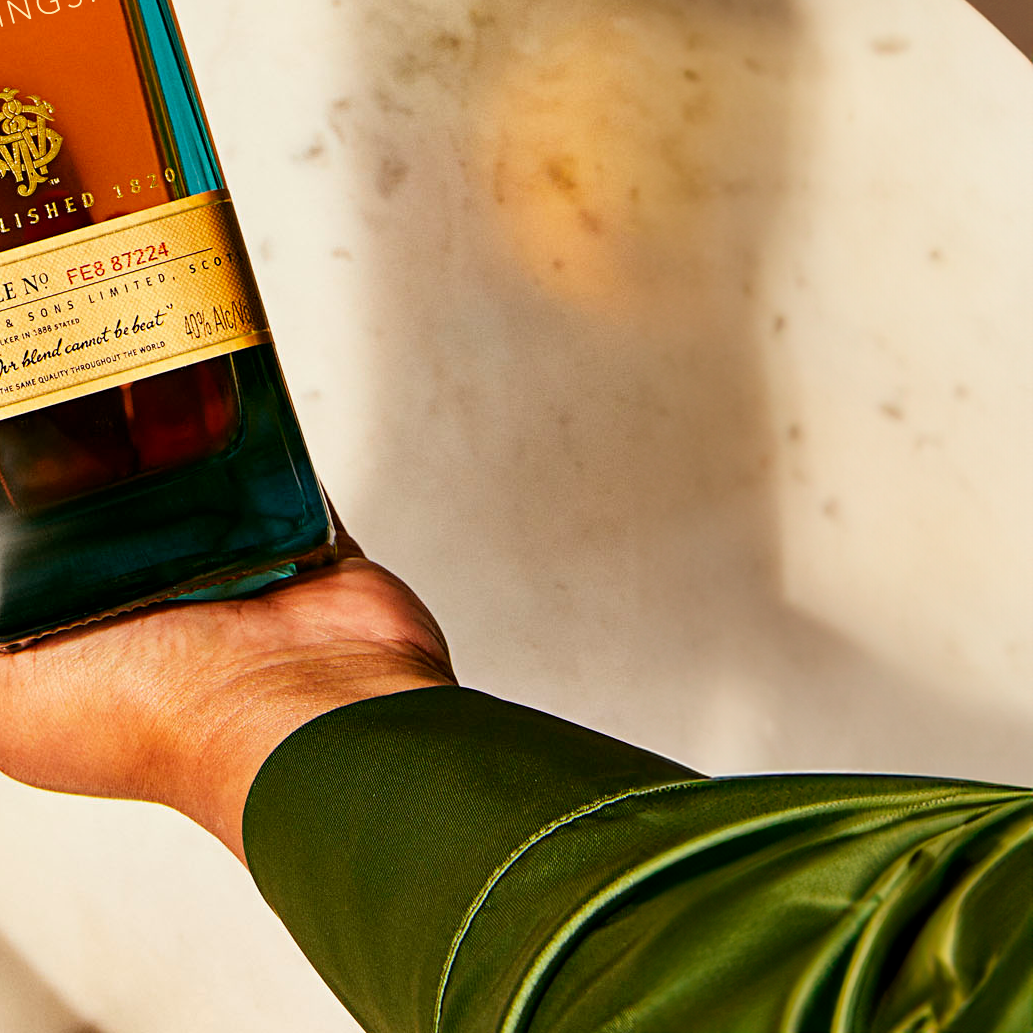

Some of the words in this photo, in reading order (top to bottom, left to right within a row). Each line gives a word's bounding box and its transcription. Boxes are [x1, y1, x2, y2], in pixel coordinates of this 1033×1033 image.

[111, 167, 177, 199] 1820
[65, 260, 106, 285] FE8
[109, 241, 170, 272] 87224
[5, 318, 15, 329] &
[27, 299, 76, 323] SONS
[21, 332, 32, 341] IN
[54, 318, 81, 331] STATED
[182, 308, 214, 341] 40%
[21, 337, 64, 368] blend
[64, 326, 113, 355] cannot
[114, 319, 131, 340] be
[0, 384, 15, 396] THE
[15, 378, 38, 392] SAME
[37, 368, 70, 385] QUALITY
[70, 353, 123, 375] THROUGHOUT
[122, 347, 139, 360] THE
[138, 340, 167, 355] WORLD
